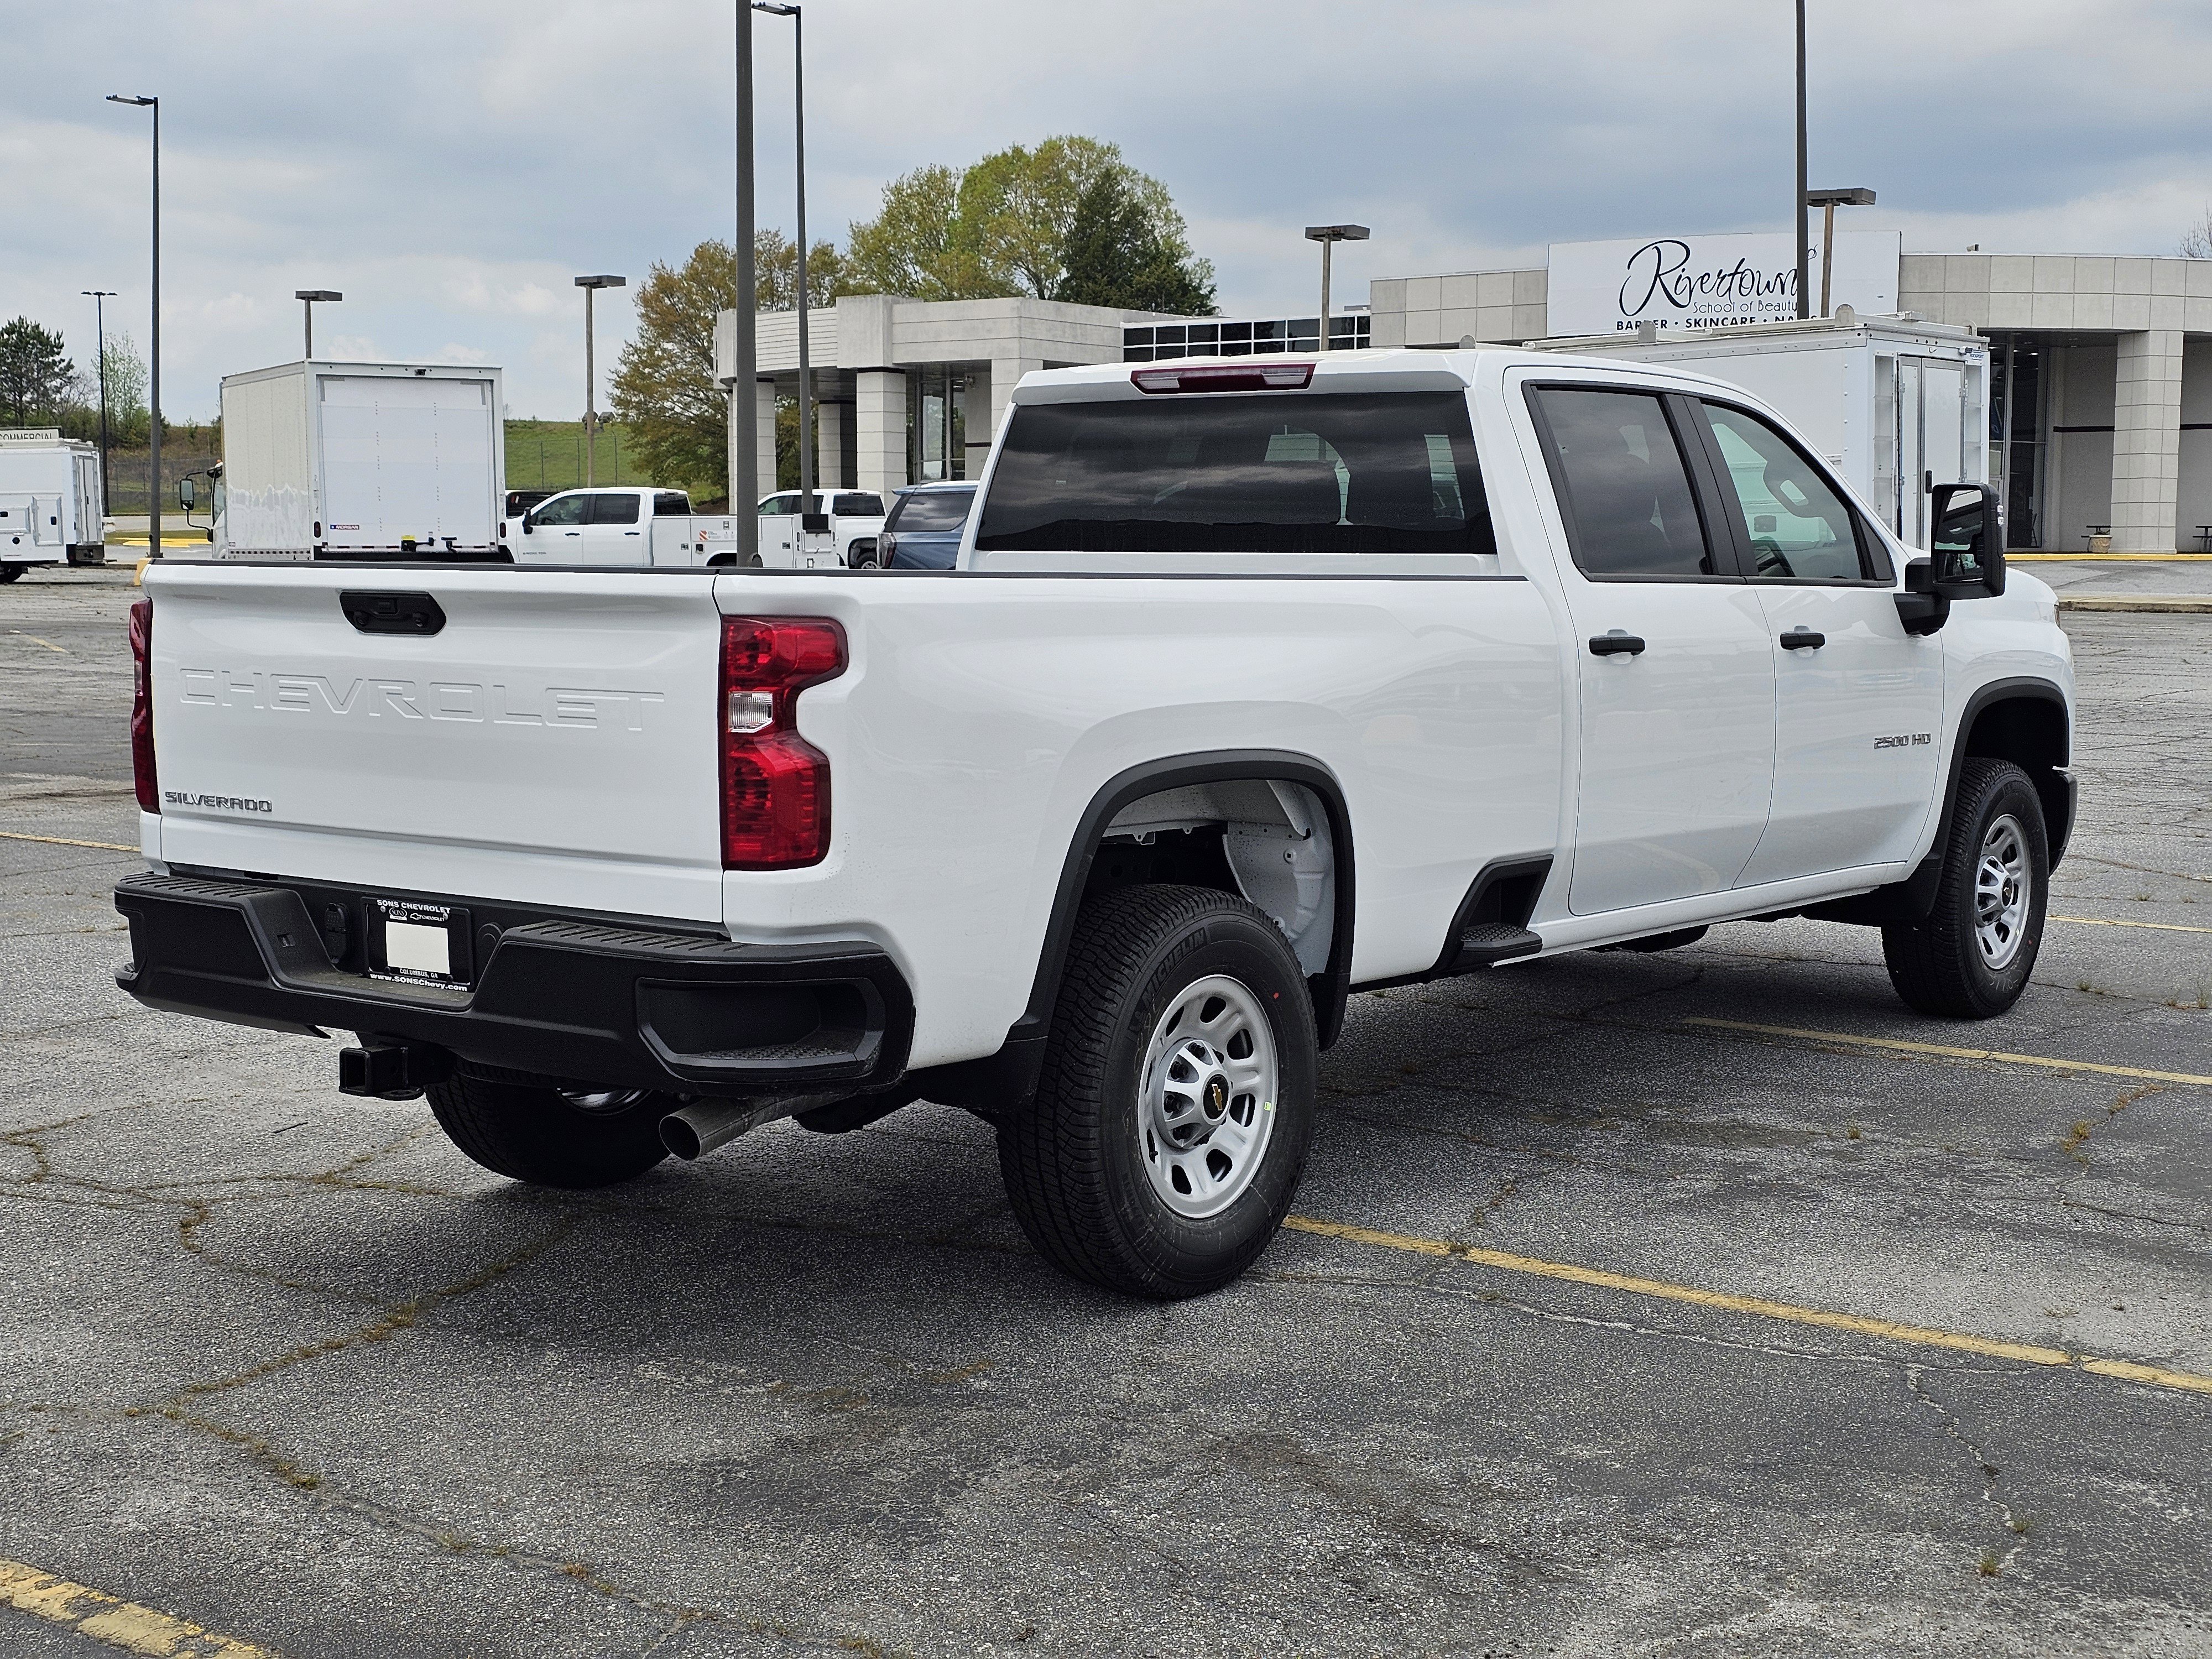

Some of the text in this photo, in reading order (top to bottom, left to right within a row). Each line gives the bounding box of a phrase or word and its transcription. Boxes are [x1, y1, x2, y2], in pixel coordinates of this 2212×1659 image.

[1619, 239, 1797, 316] Rivertown
[1693, 300, 1797, 314] School of Beauty
[1616, 316, 1756, 331] BARER SKINCARE
[180, 667, 665, 731] CHEVROLET
[1874, 733, 1931, 749] 2500 HD
[165, 791, 273, 812] SILVERADO
[377, 899, 451, 914] SONS CHEVROLET
[1141, 928, 1206, 1009] MICHELIN
[370, 973, 467, 992] www.SONSChevy.com
